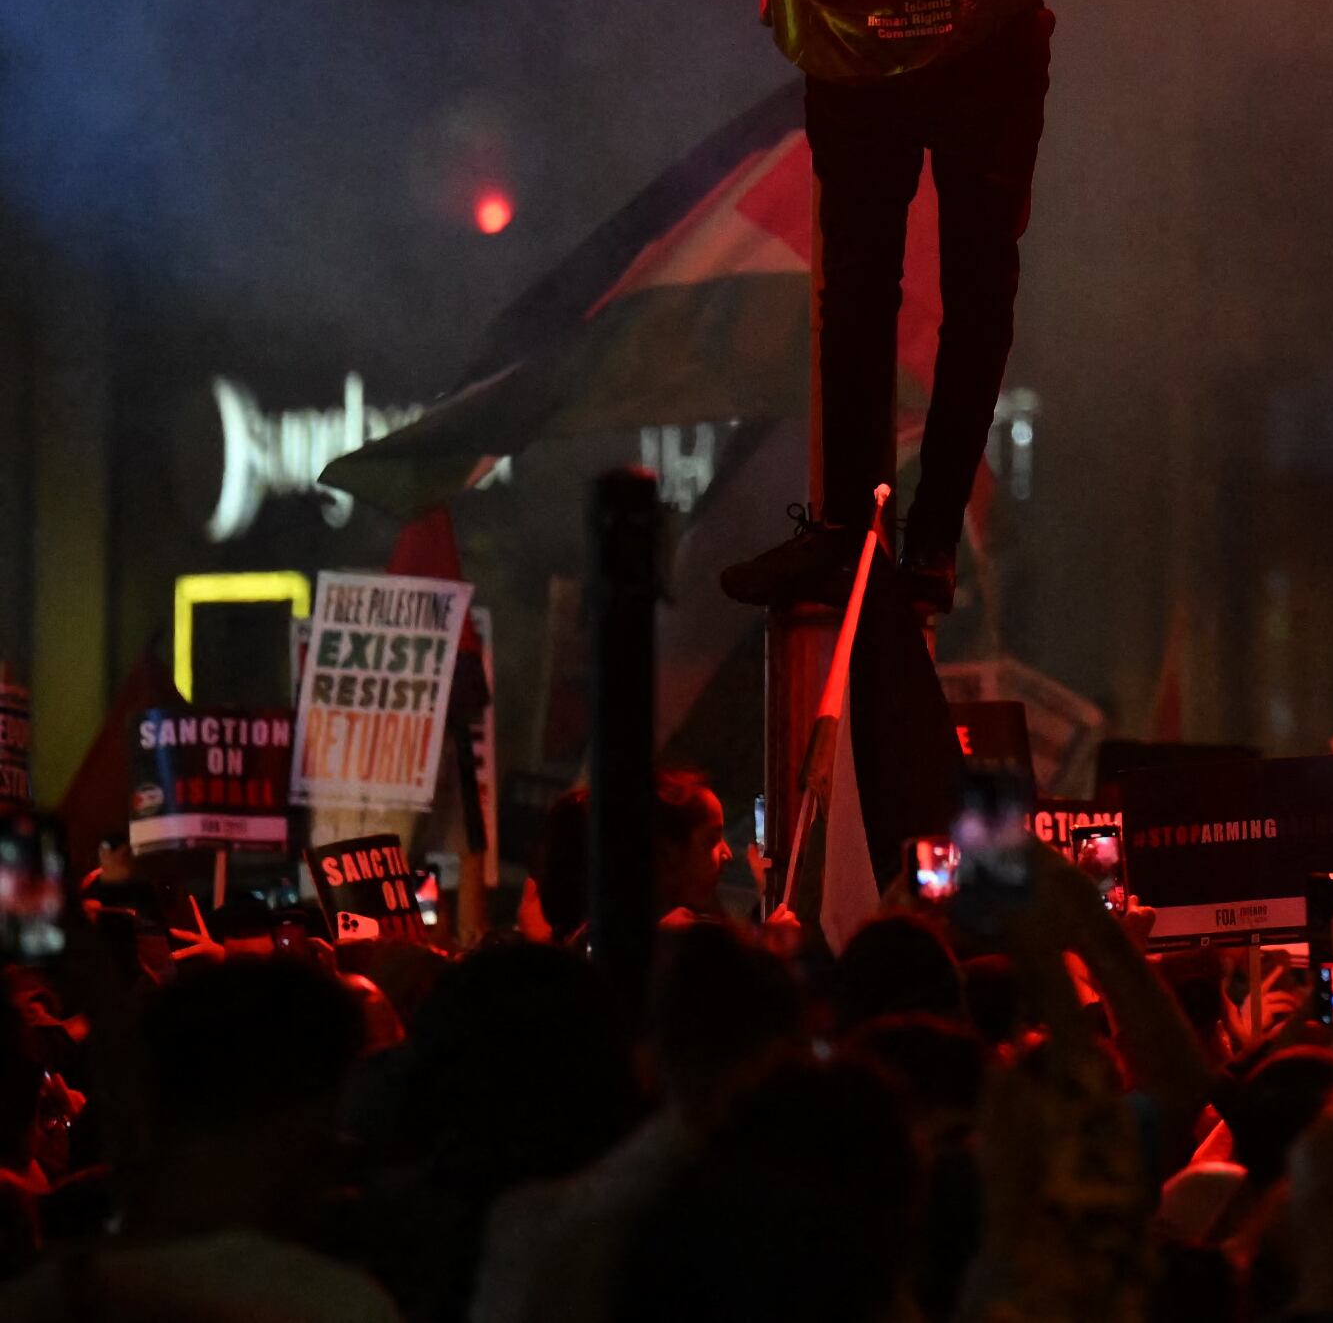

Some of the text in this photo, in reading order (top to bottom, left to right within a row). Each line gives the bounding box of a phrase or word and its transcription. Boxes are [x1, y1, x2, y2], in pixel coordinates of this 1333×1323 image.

[316, 628, 447, 675] EXIST!
[312, 673, 440, 712] RESIST!
[207, 747, 244, 776] ON
[303, 707, 433, 787] RETURN!
[1216, 908, 1236, 926] FOA
